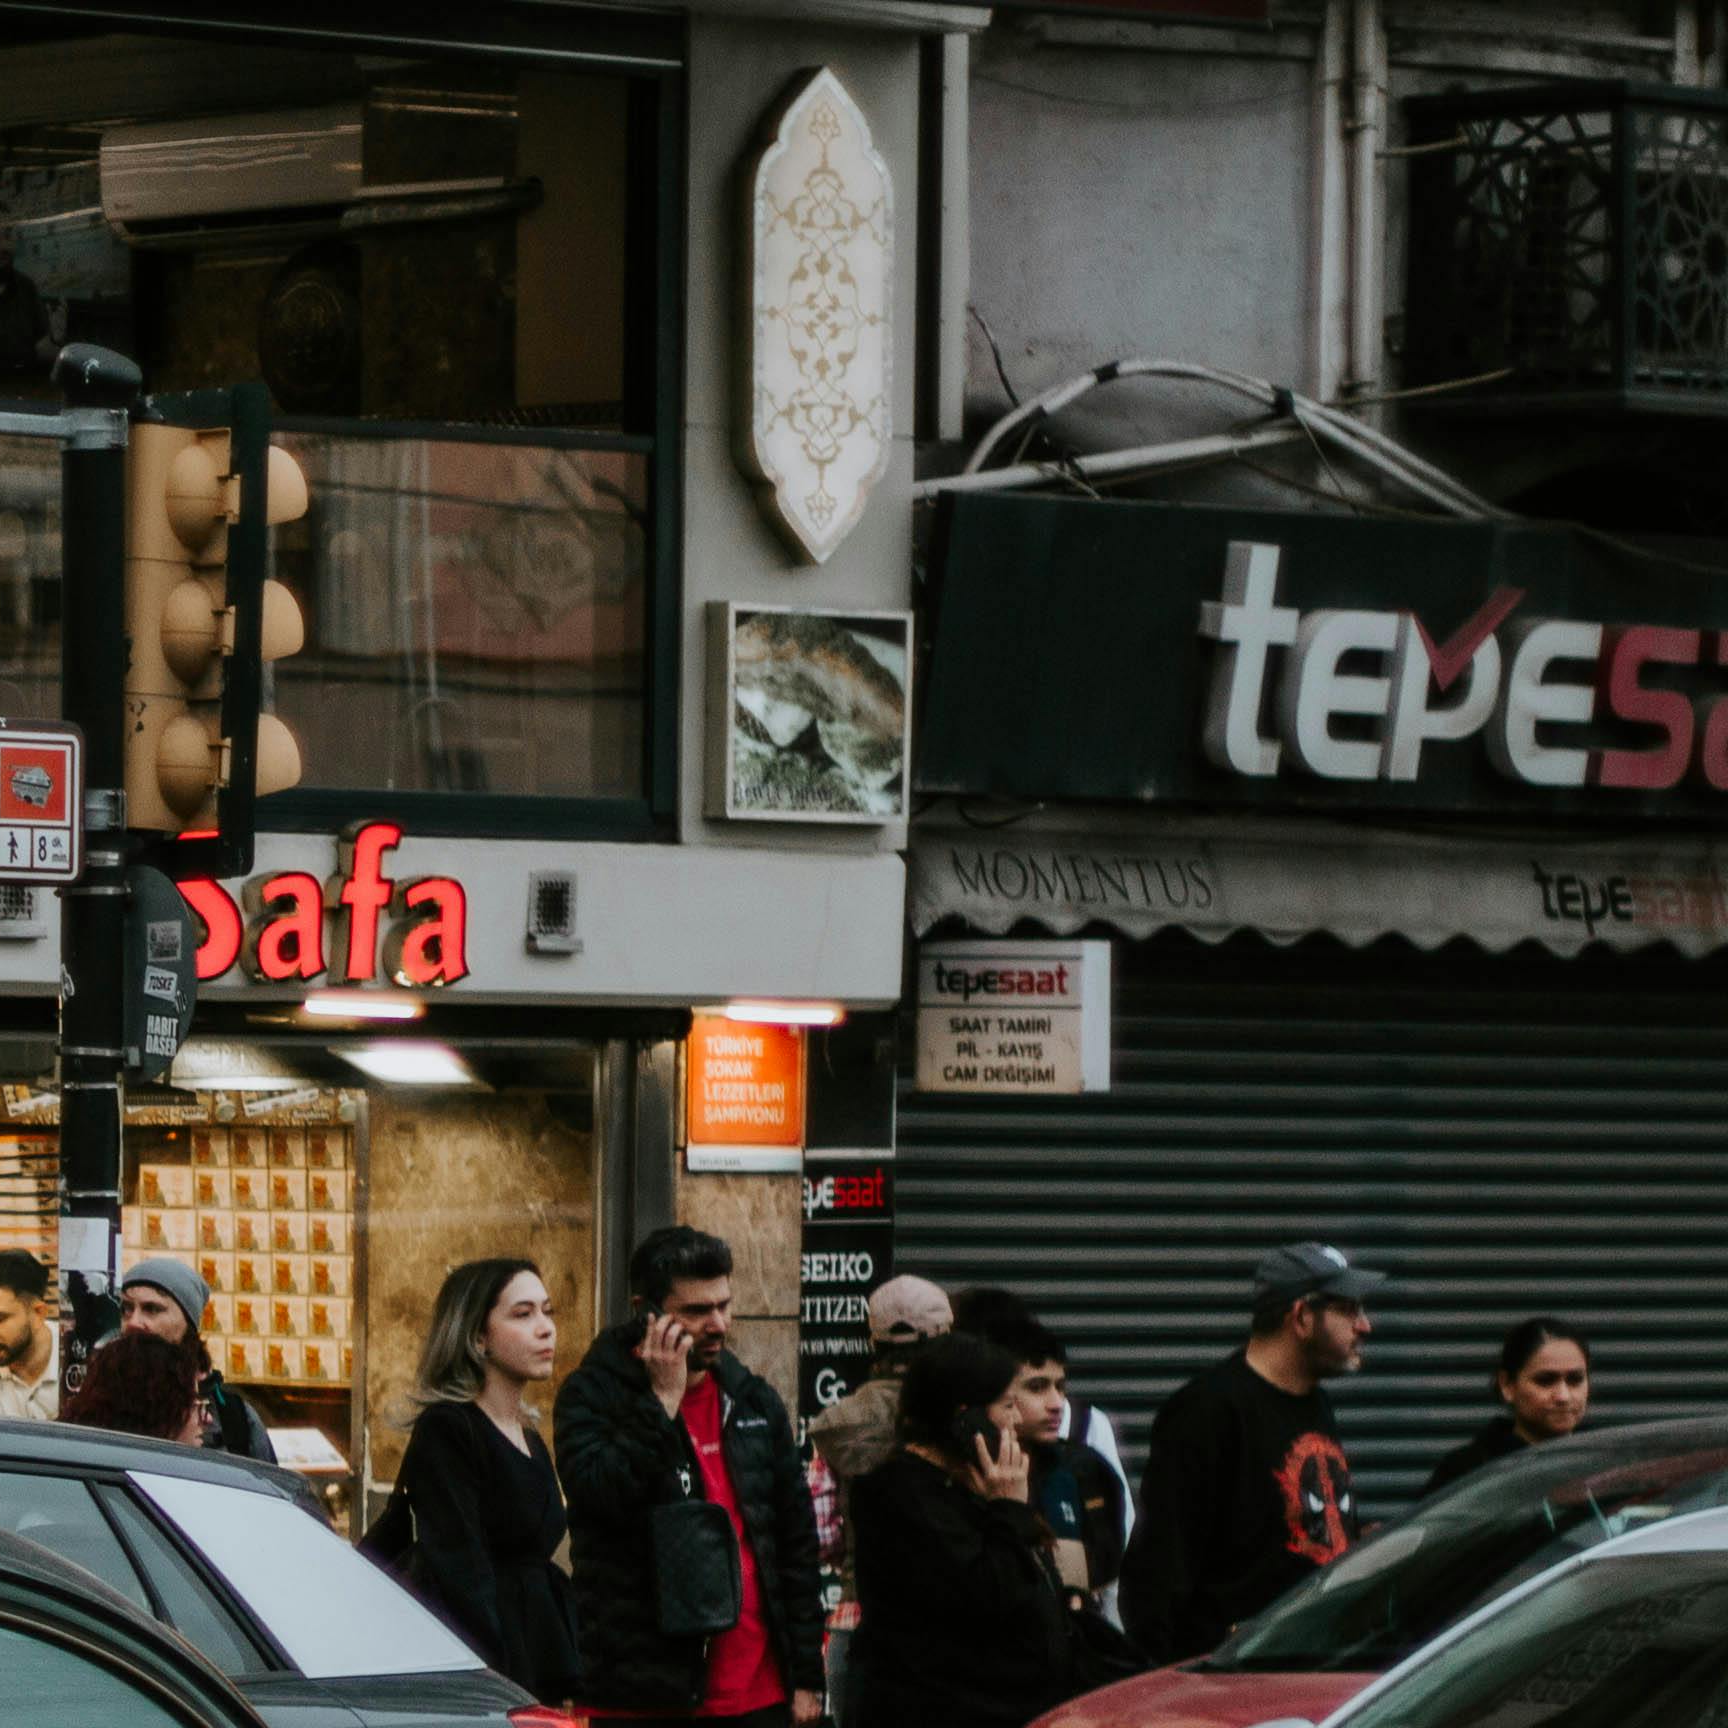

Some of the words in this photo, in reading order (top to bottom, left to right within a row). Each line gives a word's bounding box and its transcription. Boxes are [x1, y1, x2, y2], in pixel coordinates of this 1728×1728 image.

[38, 836, 47, 862] 8
[949, 849, 1212, 908] MOMENTUS
[934, 961, 1069, 1001] tepesaat
[949, 1018, 991, 1034] SAAT
[944, 1067, 977, 1082] CAM
[802, 1168, 885, 1219] pesaat
[800, 1296, 870, 1322] ITIZEN
